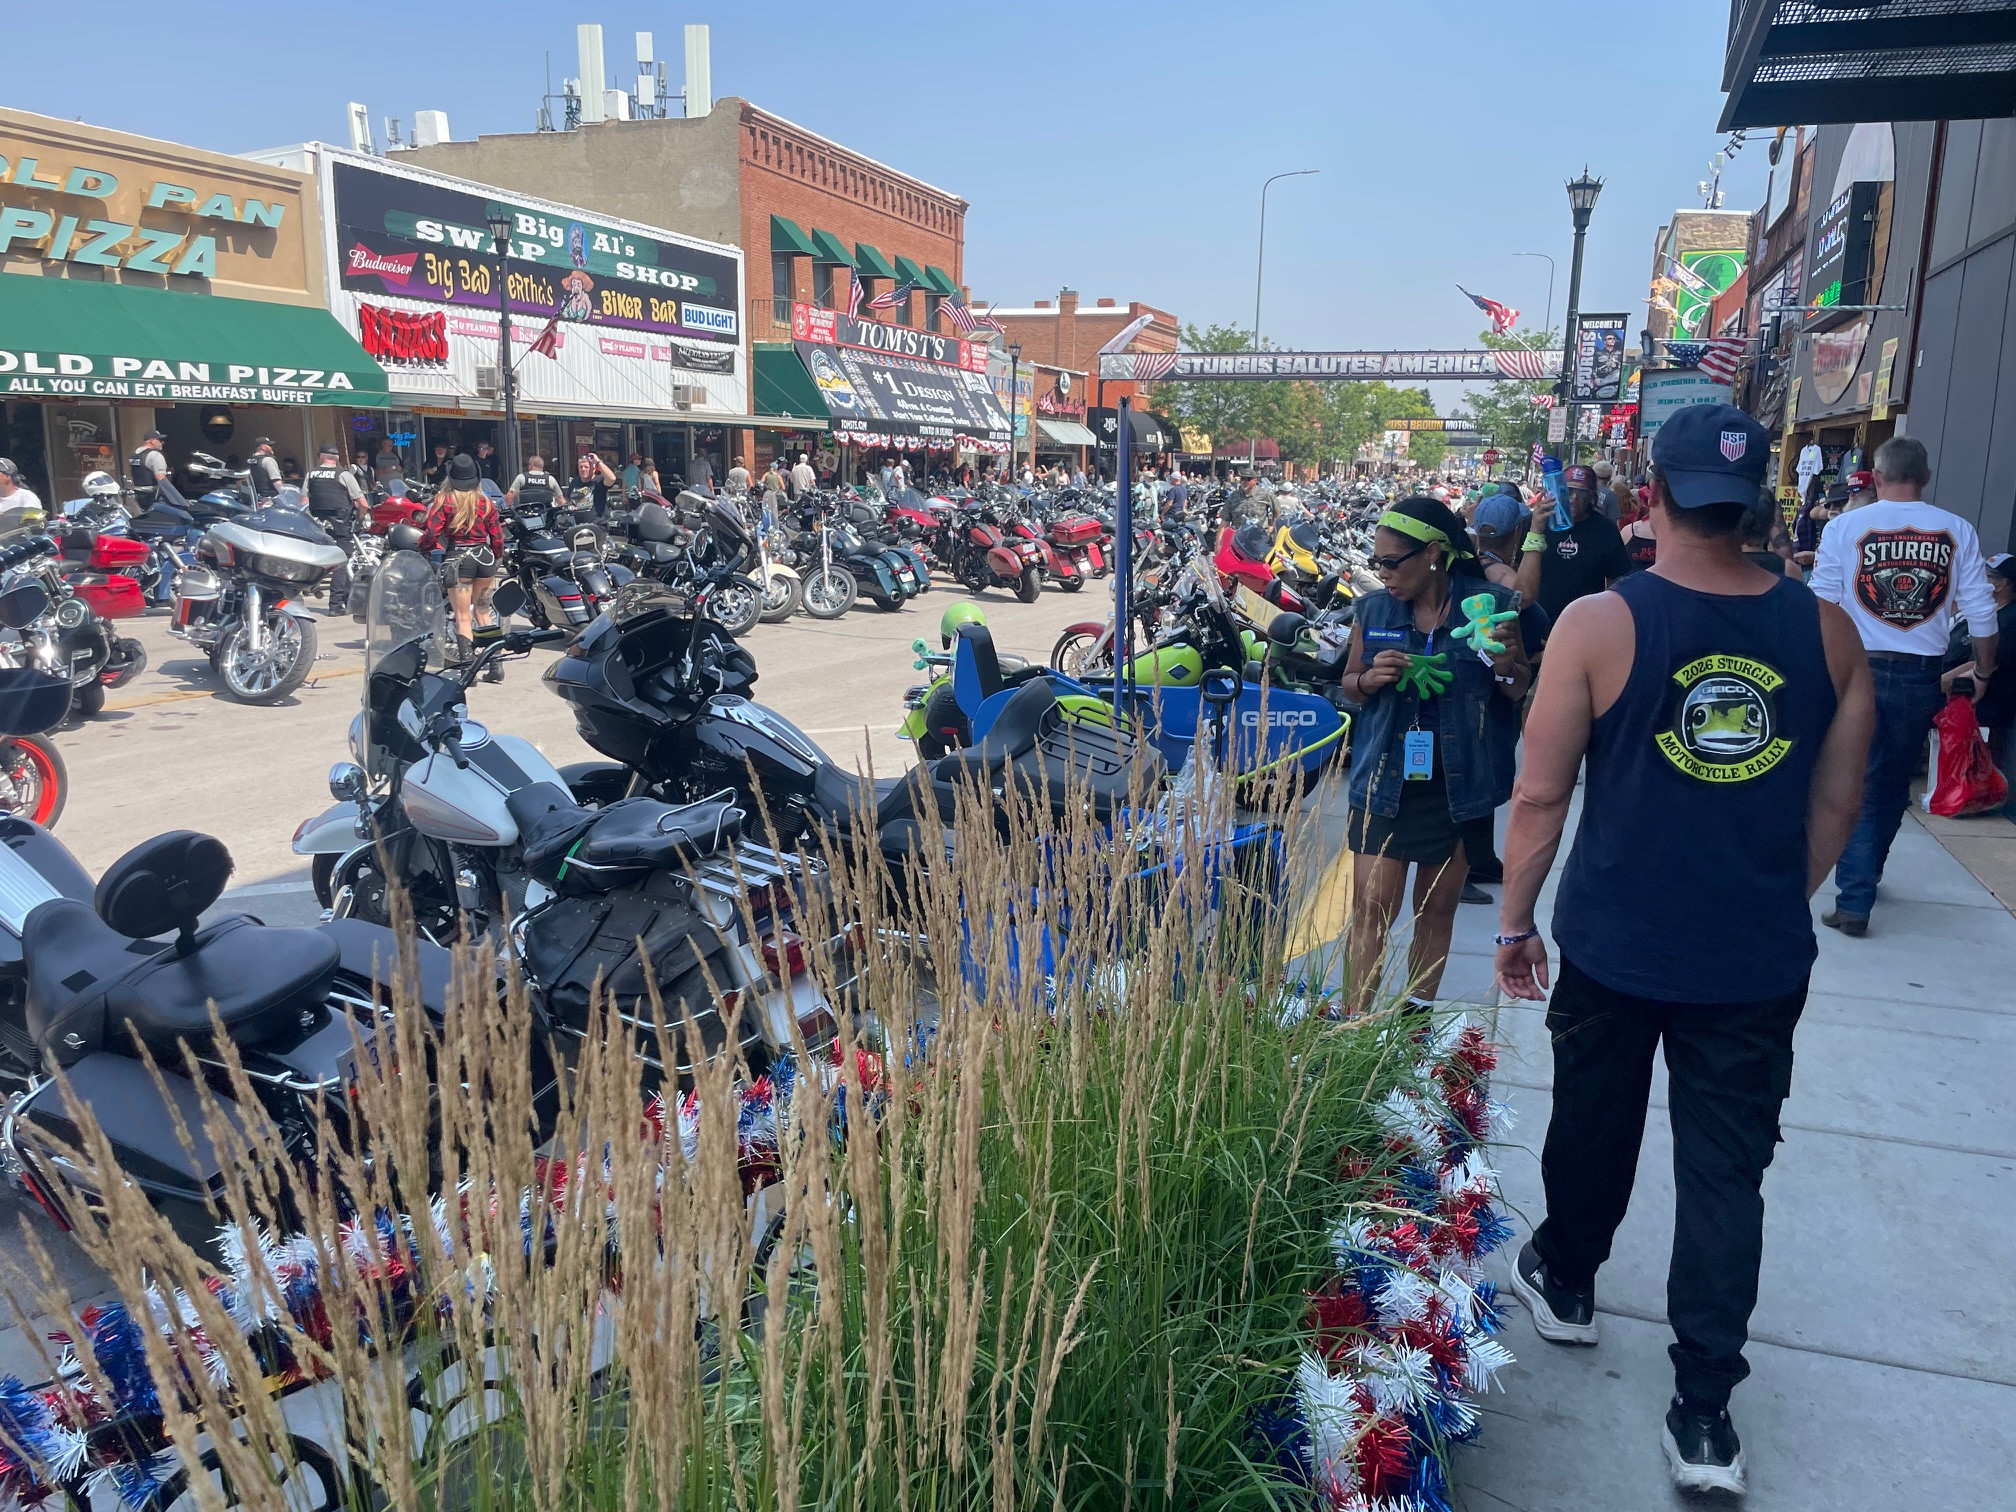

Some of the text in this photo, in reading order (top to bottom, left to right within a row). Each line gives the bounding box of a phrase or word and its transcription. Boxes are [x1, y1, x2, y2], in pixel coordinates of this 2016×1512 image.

[0, 155, 286, 228] LD PAN
[0, 206, 216, 278] PIZZA
[515, 212, 635, 257] Big Al's
[349, 249, 413, 275] Budweiser
[616, 261, 699, 291] SHOP
[684, 308, 734, 329] BUD LIGHT
[1582, 320, 1623, 329] WELCOME TO
[359, 302, 449, 362] BADASS
[465, 323, 498, 335] PEANUTS
[857, 320, 918, 355] TOM'S
[919, 334, 946, 360] T'S
[619, 346, 643, 355] PEANUTS
[112, 357, 210, 382] PAN
[228, 364, 354, 390] PIZZA
[1175, 356, 1497, 374] STURGIS SALUTES AMERICA
[1577, 331, 1597, 397] STURGIS
[9, 378, 314, 404] ALL YOU CAN EAT BREAKFAST BUFFET
[872, 370, 902, 395] #1
[1660, 378, 1696, 387] PRESIDIO
[924, 413, 952, 424] Collection
[1409, 419, 1444, 431] BROWN
[1722, 432, 1746, 444] USA
[310, 470, 336, 479] POLICE
[528, 477, 546, 485] POLICE
[1863, 541, 1951, 567] STURGIS
[1877, 560, 1918, 568] MOTORCYCLE
[1860, 574, 1872, 583] 20
[1881, 611, 1924, 620] South Dakota
[1682, 658, 1775, 686] 2026 STURGIS
[1701, 685, 1747, 694] GEICO
[1241, 710, 1317, 727] GEICO
[1661, 734, 1785, 780] MOTORCYCLE RALLY
